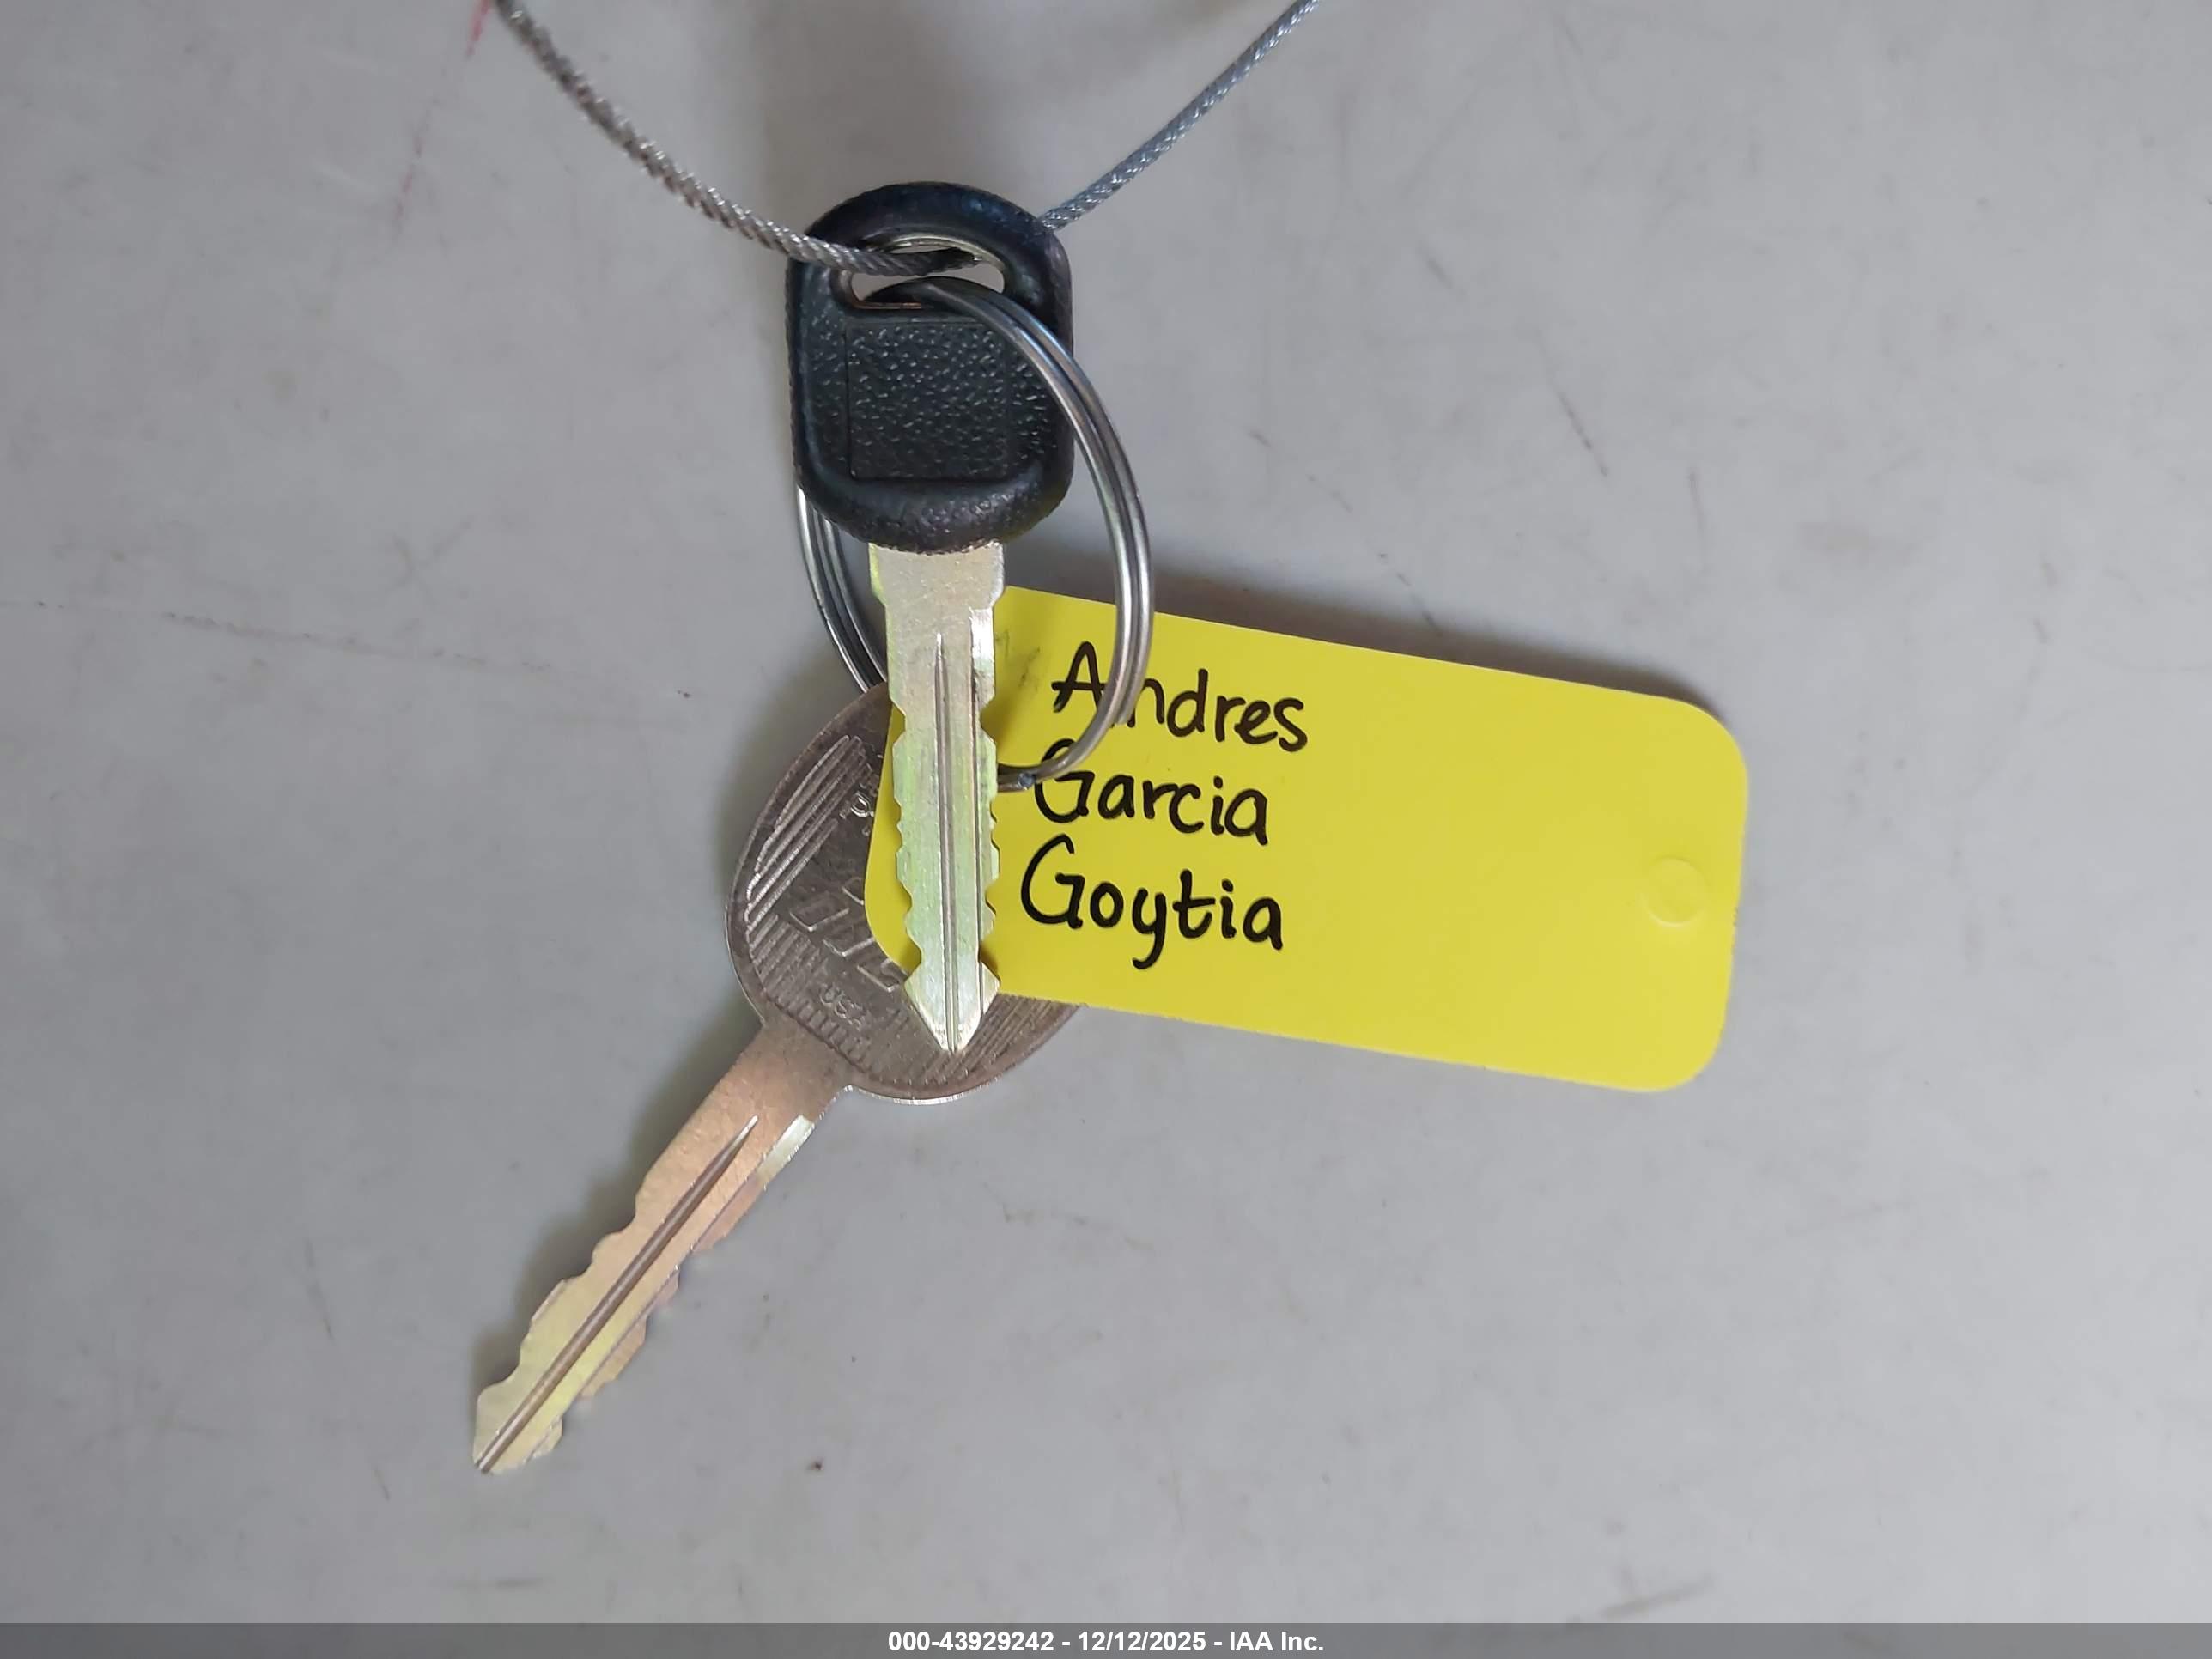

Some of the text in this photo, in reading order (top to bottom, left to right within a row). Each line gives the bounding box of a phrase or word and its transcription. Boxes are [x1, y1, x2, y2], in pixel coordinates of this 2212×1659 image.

[1051, 641, 1308, 752] Andres
[1034, 738, 1268, 845] Garcia
[1021, 834, 1283, 969] Goytia
